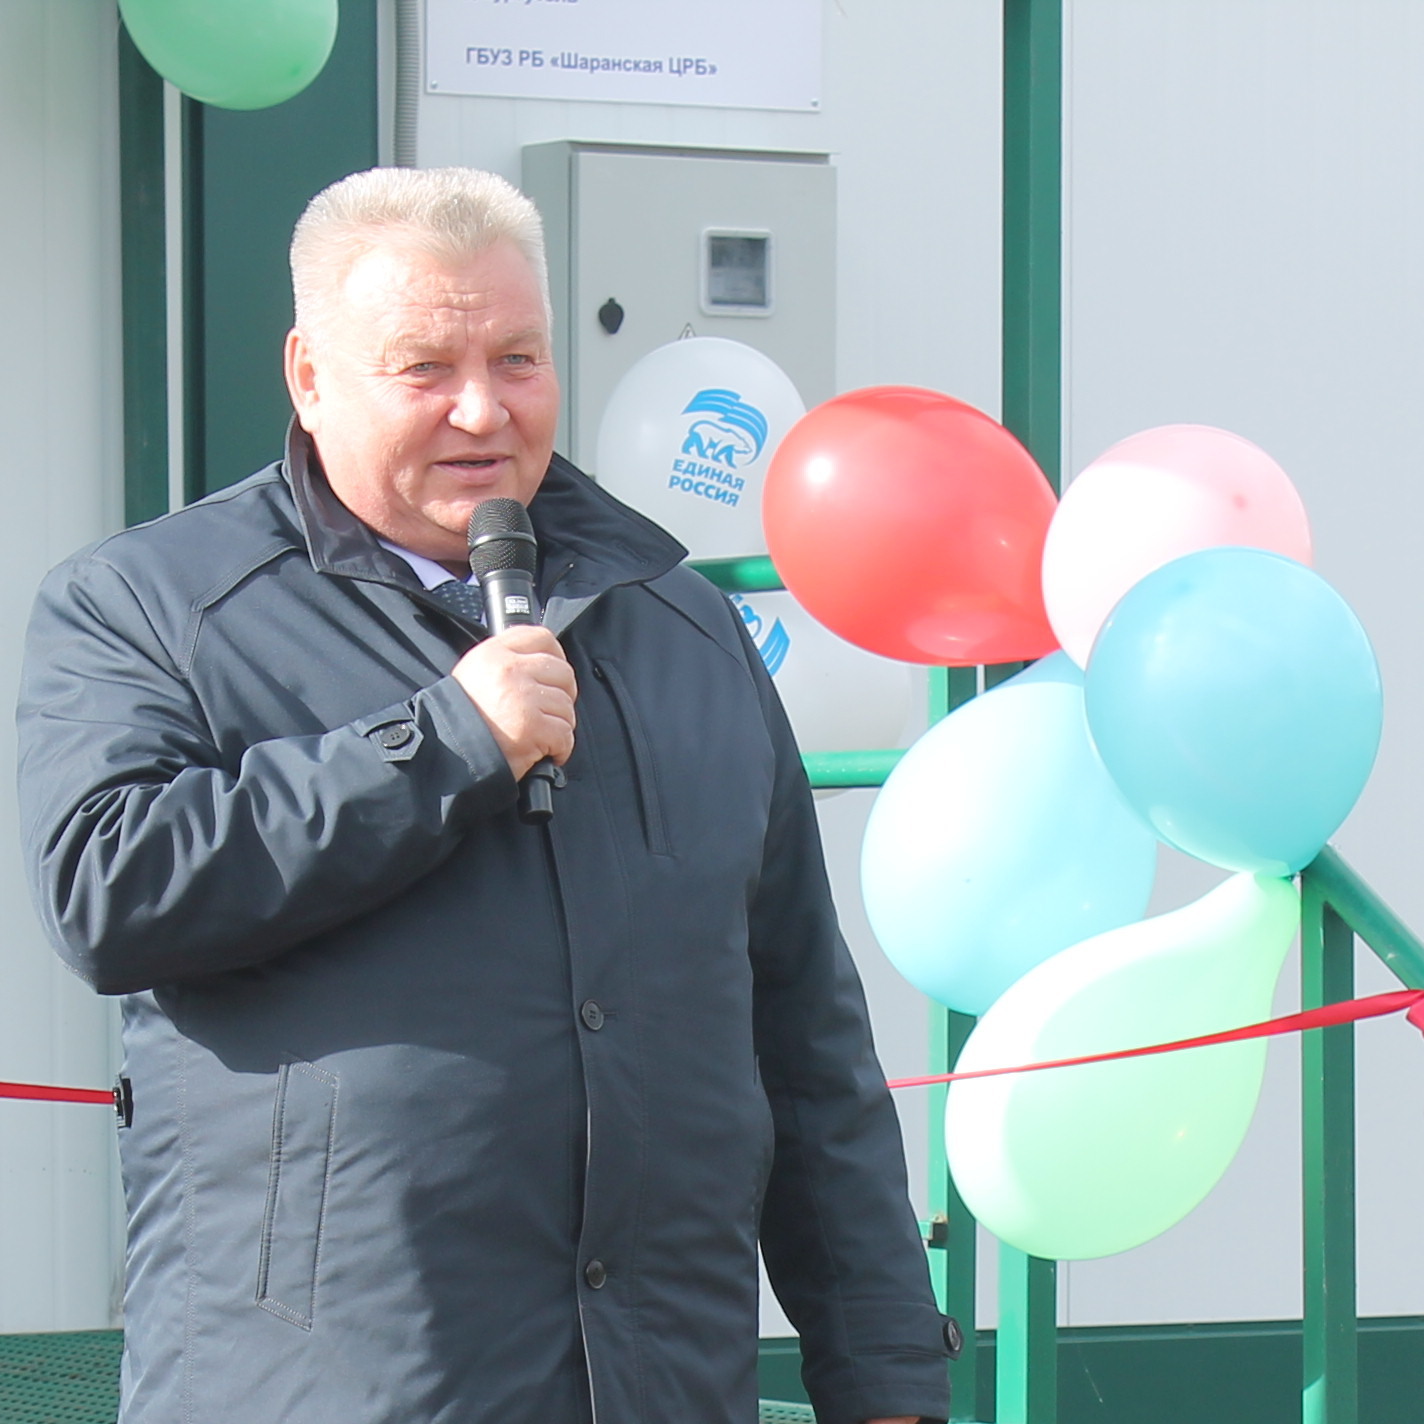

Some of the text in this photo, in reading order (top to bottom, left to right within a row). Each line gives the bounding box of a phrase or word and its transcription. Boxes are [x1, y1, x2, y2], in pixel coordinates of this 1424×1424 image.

[466, 46, 718, 77] ГБУЗ РБ «Шаранская ЦРБ»
[672, 458, 745, 491] ЕДИНАЯ
[668, 475, 740, 507] РОССИЯ
